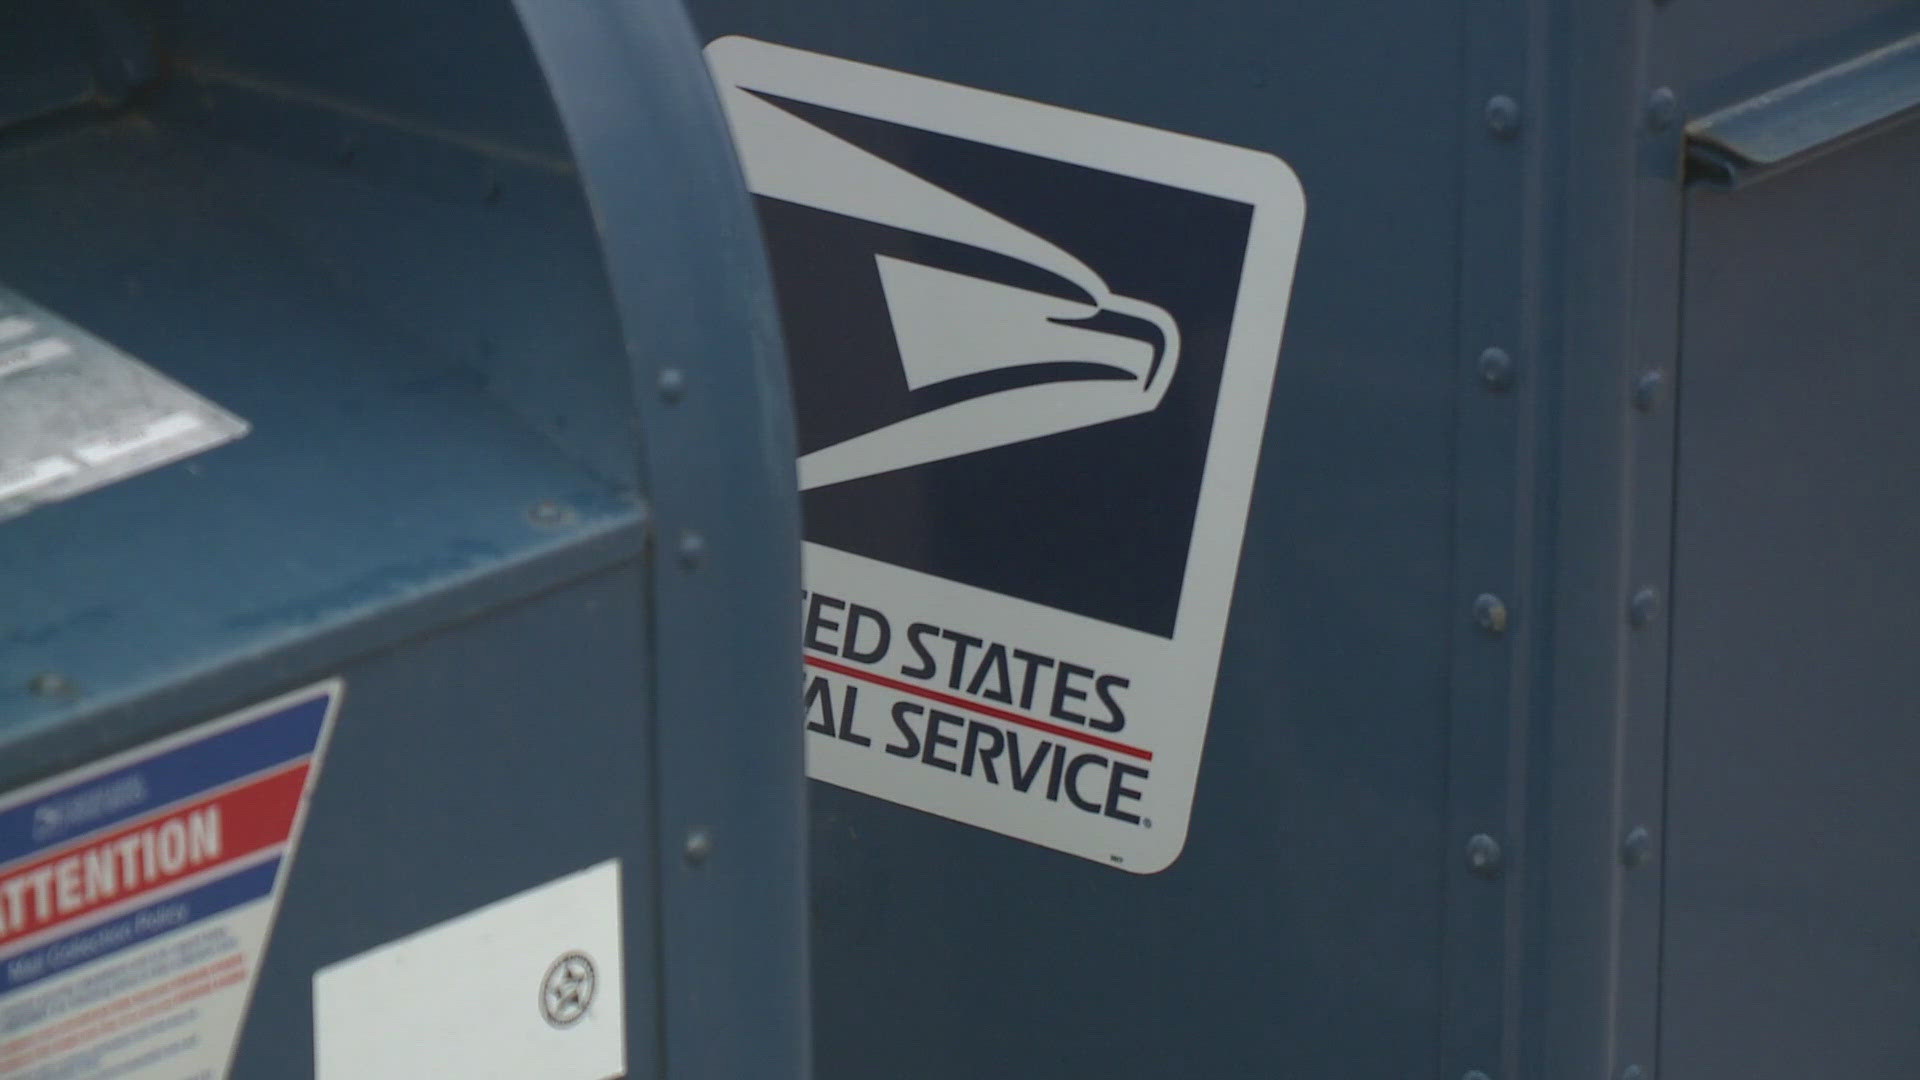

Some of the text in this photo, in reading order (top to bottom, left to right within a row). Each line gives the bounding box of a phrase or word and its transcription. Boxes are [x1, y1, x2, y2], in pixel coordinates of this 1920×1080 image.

[801, 590, 1130, 733] ED STATES
[802, 672, 1150, 826] AL SERVICE
